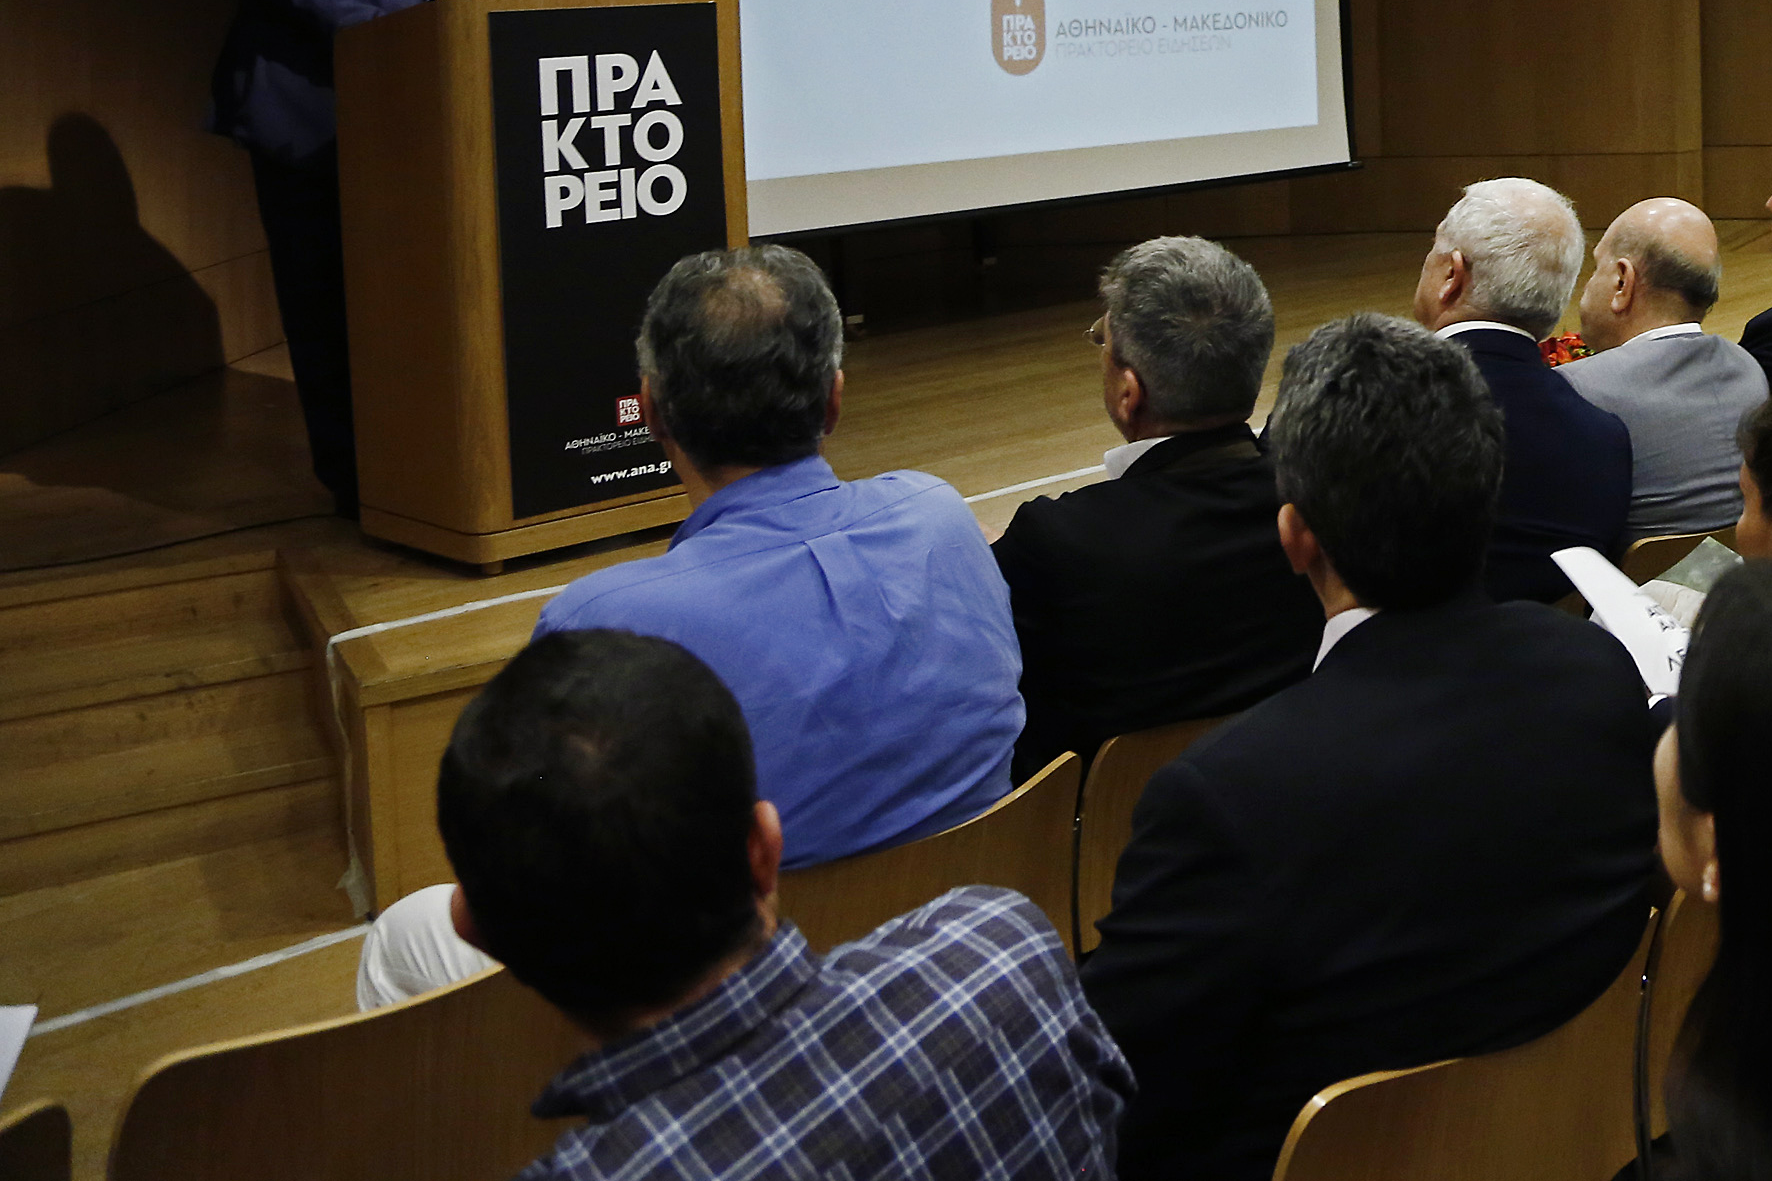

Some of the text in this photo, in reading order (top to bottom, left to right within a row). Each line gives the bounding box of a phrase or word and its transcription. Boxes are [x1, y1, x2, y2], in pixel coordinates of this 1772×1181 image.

[1002, 14, 1036, 31] ΠΡΑ
[1173, 10, 1288, 33] ΜΑΚΕΔΟΝΙΚΟ
[1003, 30, 1036, 46] ΚΤΟ
[1003, 45, 1037, 61] ΡΕΙΟ
[1055, 38, 1153, 59] ΠΡΑΚΤΟΡΕΙΟ
[538, 49, 683, 116] ΠΡΑ
[541, 109, 684, 173] ΚΤΟ
[544, 163, 688, 229] ΡΕΙΟ
[619, 398, 639, 409] ΠΡΑ
[619, 406, 640, 416] ΚΤΟ
